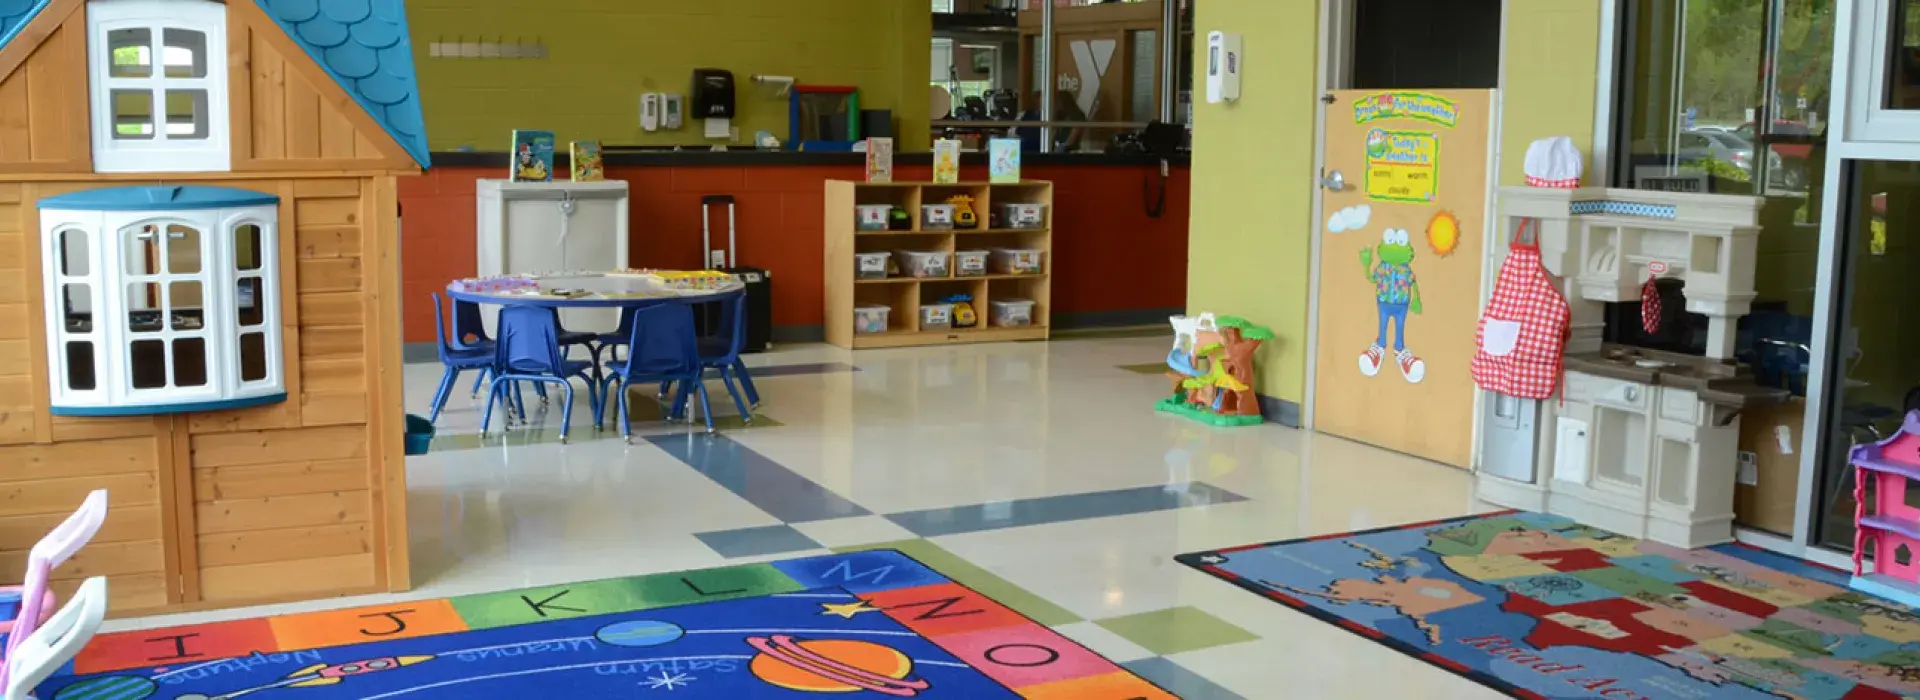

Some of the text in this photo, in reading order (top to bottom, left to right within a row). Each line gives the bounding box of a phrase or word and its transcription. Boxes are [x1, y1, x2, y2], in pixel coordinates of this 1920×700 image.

[1058, 39, 1116, 119] the Y
[144, 576, 747, 661] I J K L
[878, 596, 985, 622] N
[456, 637, 598, 663] Uranus
[984, 643, 1060, 668] O
[1457, 634, 1584, 675] Read
[157, 648, 322, 686] Neptune
[595, 657, 740, 678] Saturn
